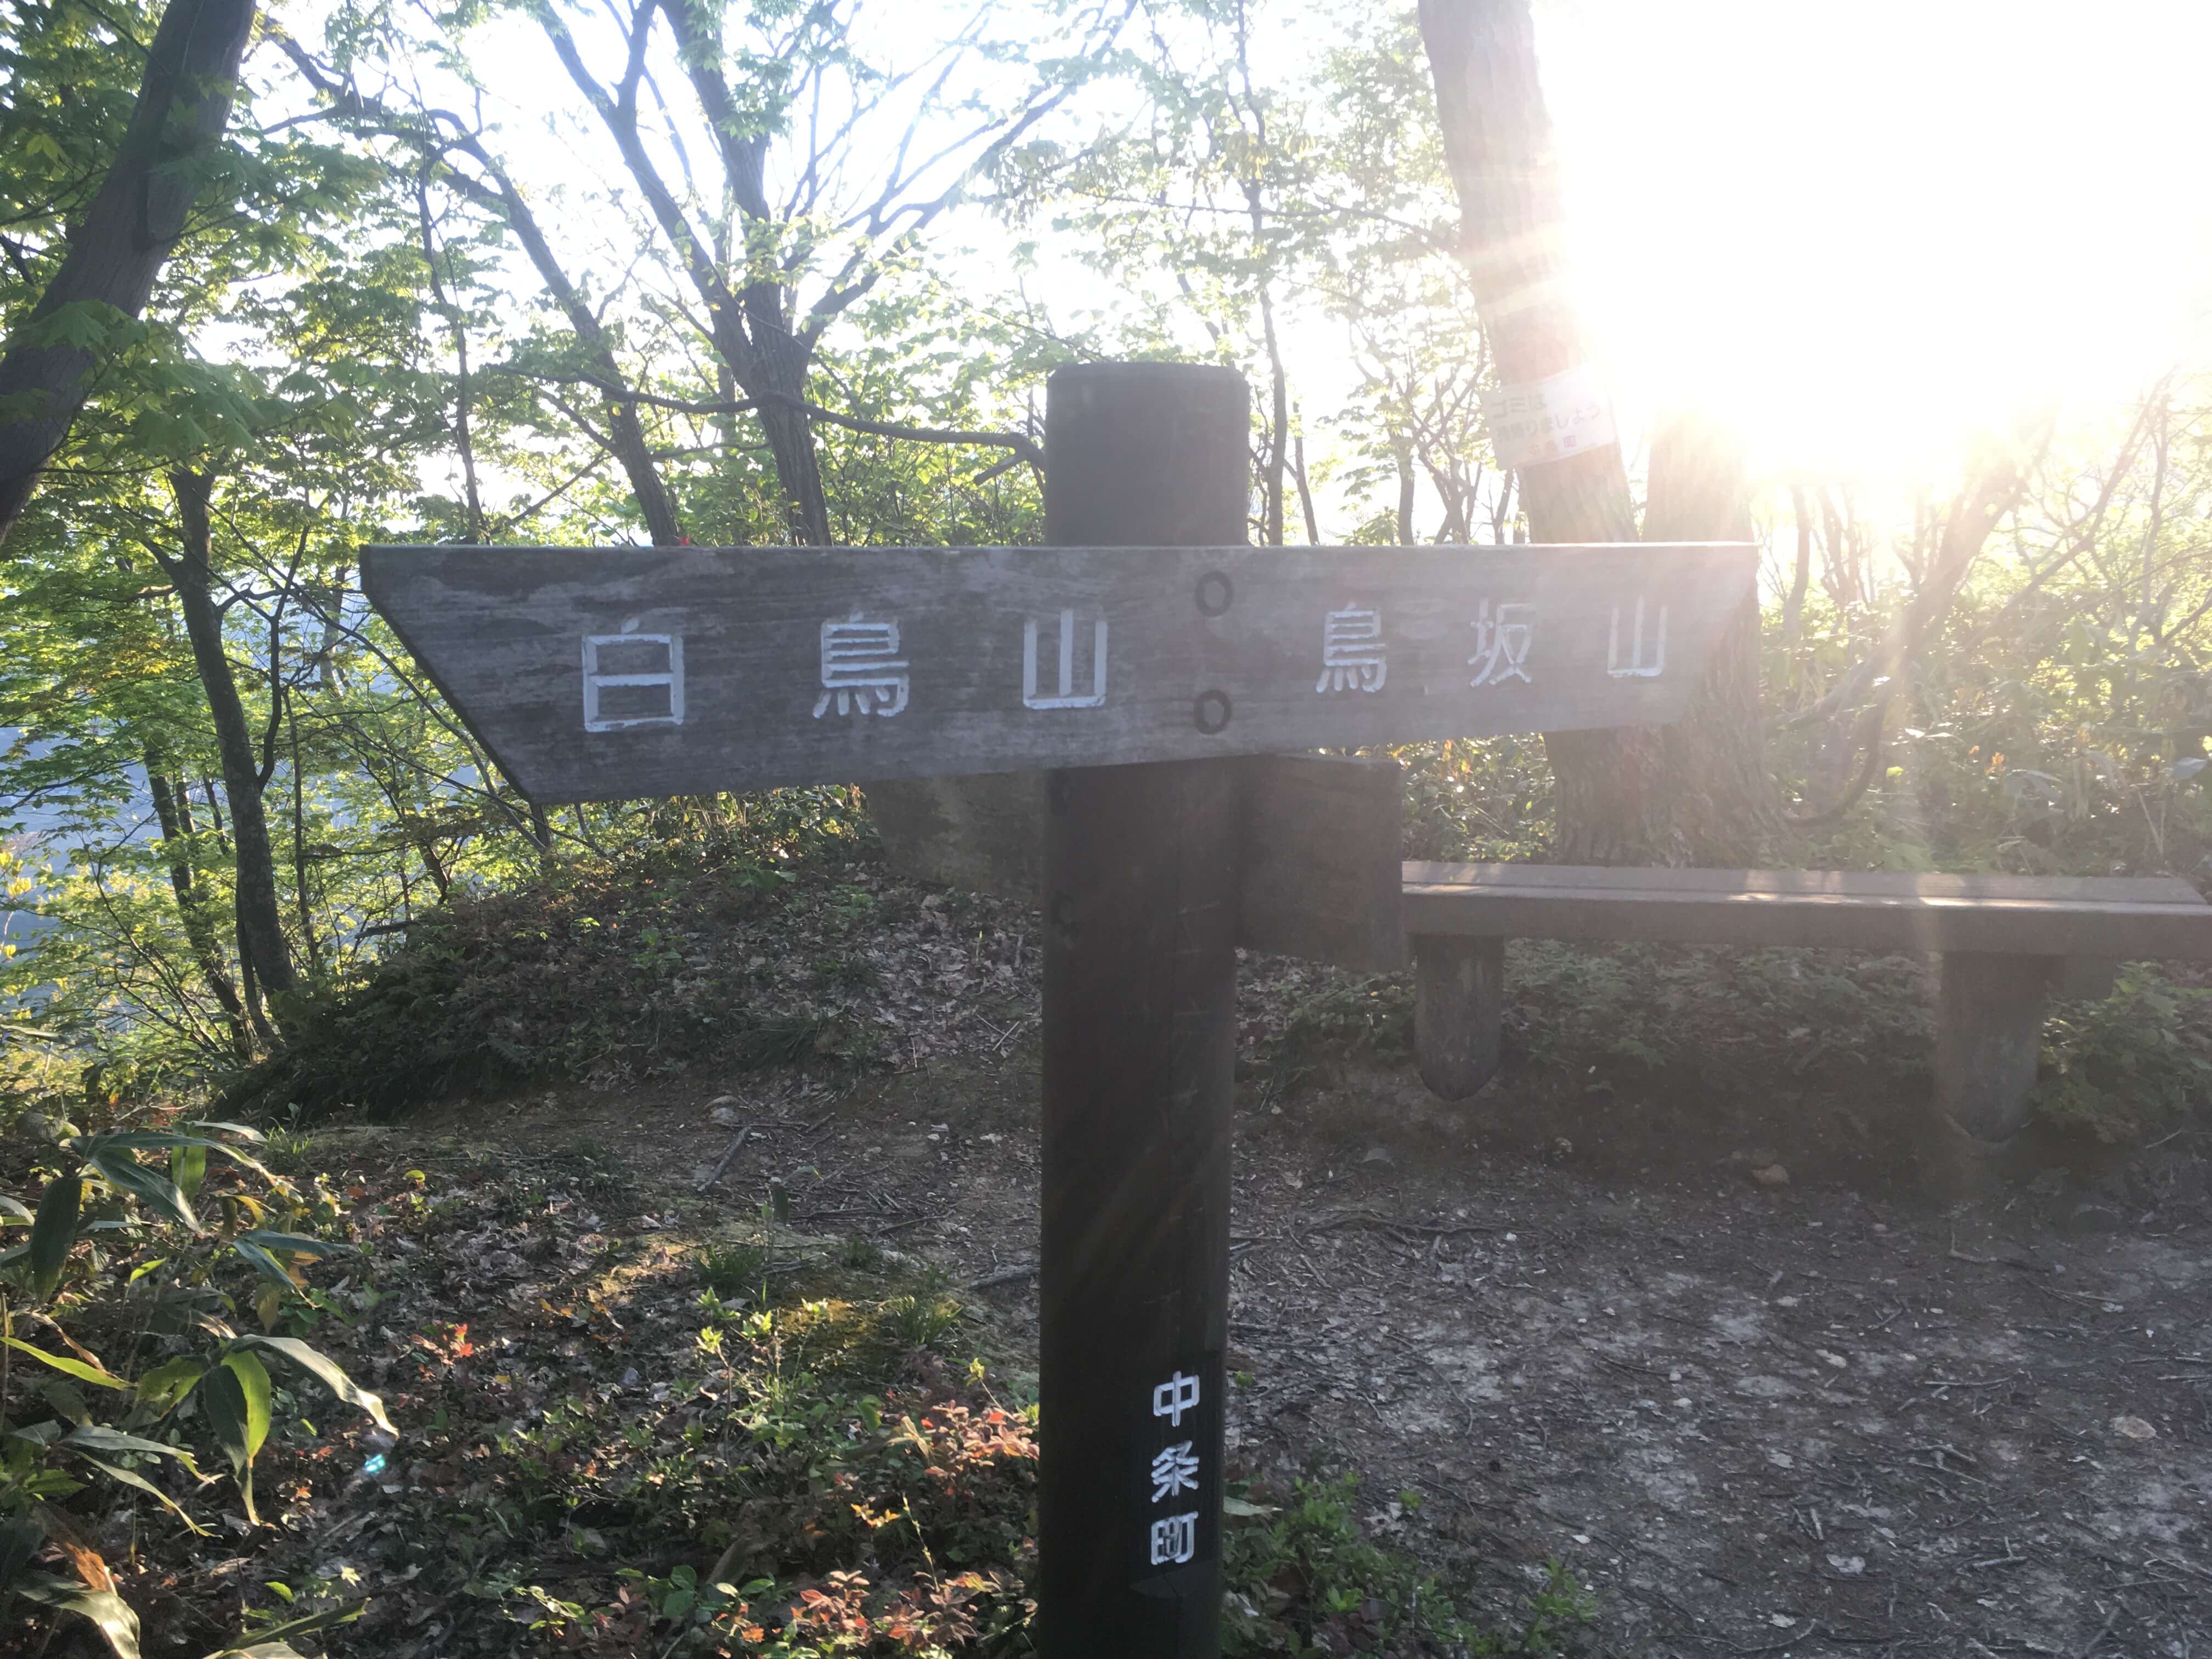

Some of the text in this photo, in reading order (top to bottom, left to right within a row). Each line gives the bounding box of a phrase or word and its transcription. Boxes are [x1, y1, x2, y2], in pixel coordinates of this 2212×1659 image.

[582, 609, 1108, 731] 白鳥山
[1316, 595, 1668, 693] 鳥坂山
[1151, 1370, 1200, 1565] 中条町
